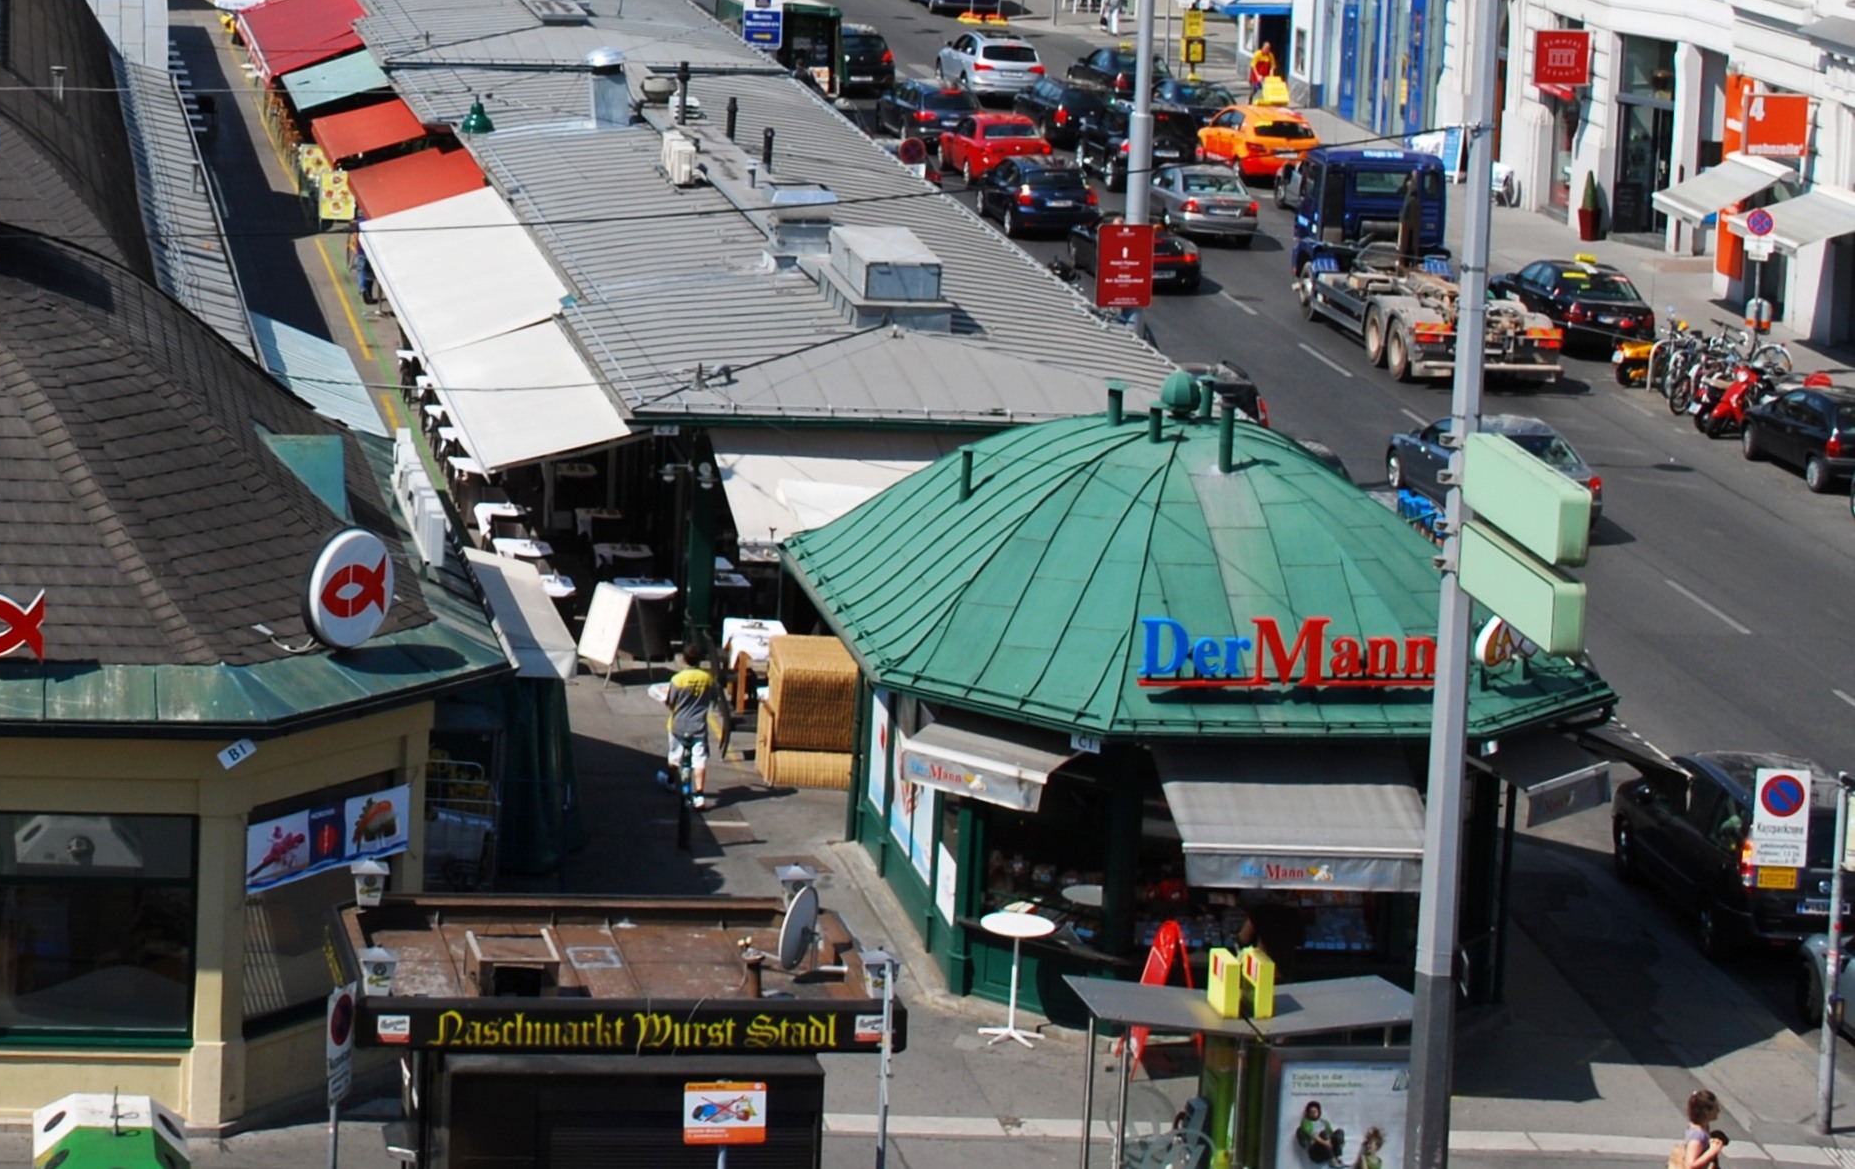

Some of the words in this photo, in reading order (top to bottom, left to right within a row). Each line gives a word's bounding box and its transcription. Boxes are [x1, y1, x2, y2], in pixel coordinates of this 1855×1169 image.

[426, 1009, 625, 1048] Naschmarkt
[632, 1012, 735, 1049] Wurst
[743, 1013, 837, 1048] Stadl
